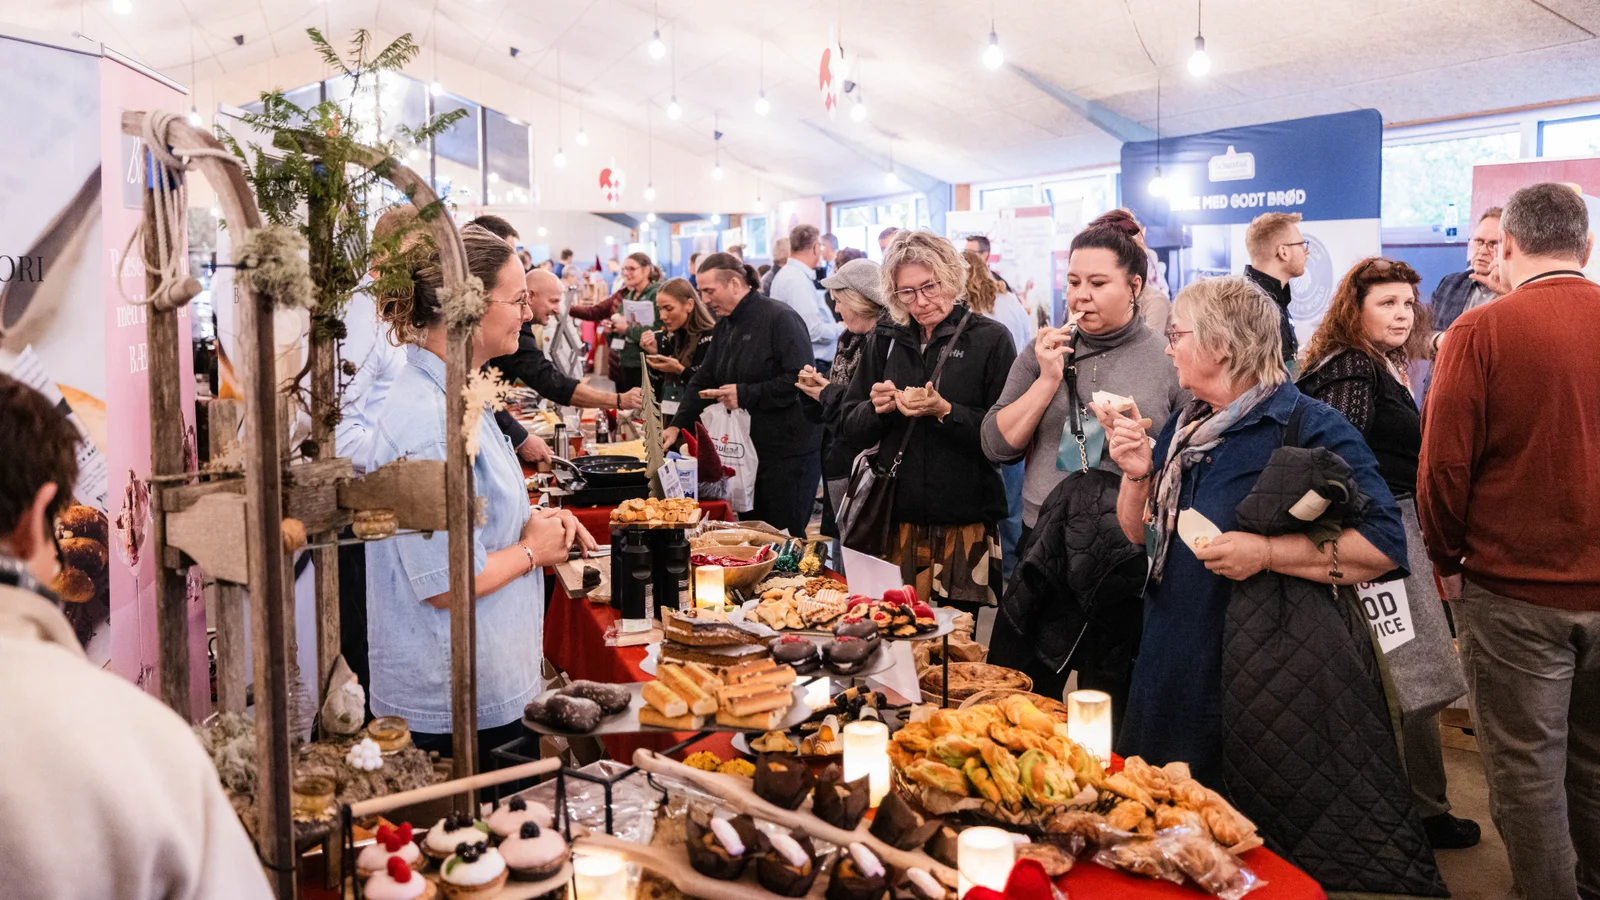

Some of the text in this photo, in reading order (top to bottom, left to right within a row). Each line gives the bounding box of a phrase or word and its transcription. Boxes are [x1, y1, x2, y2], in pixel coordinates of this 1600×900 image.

[1203, 194, 1228, 209] MED
[1230, 192, 1265, 208] GODT
[1267, 189, 1306, 206] BRØD
[0, 255, 44, 282] ORI
